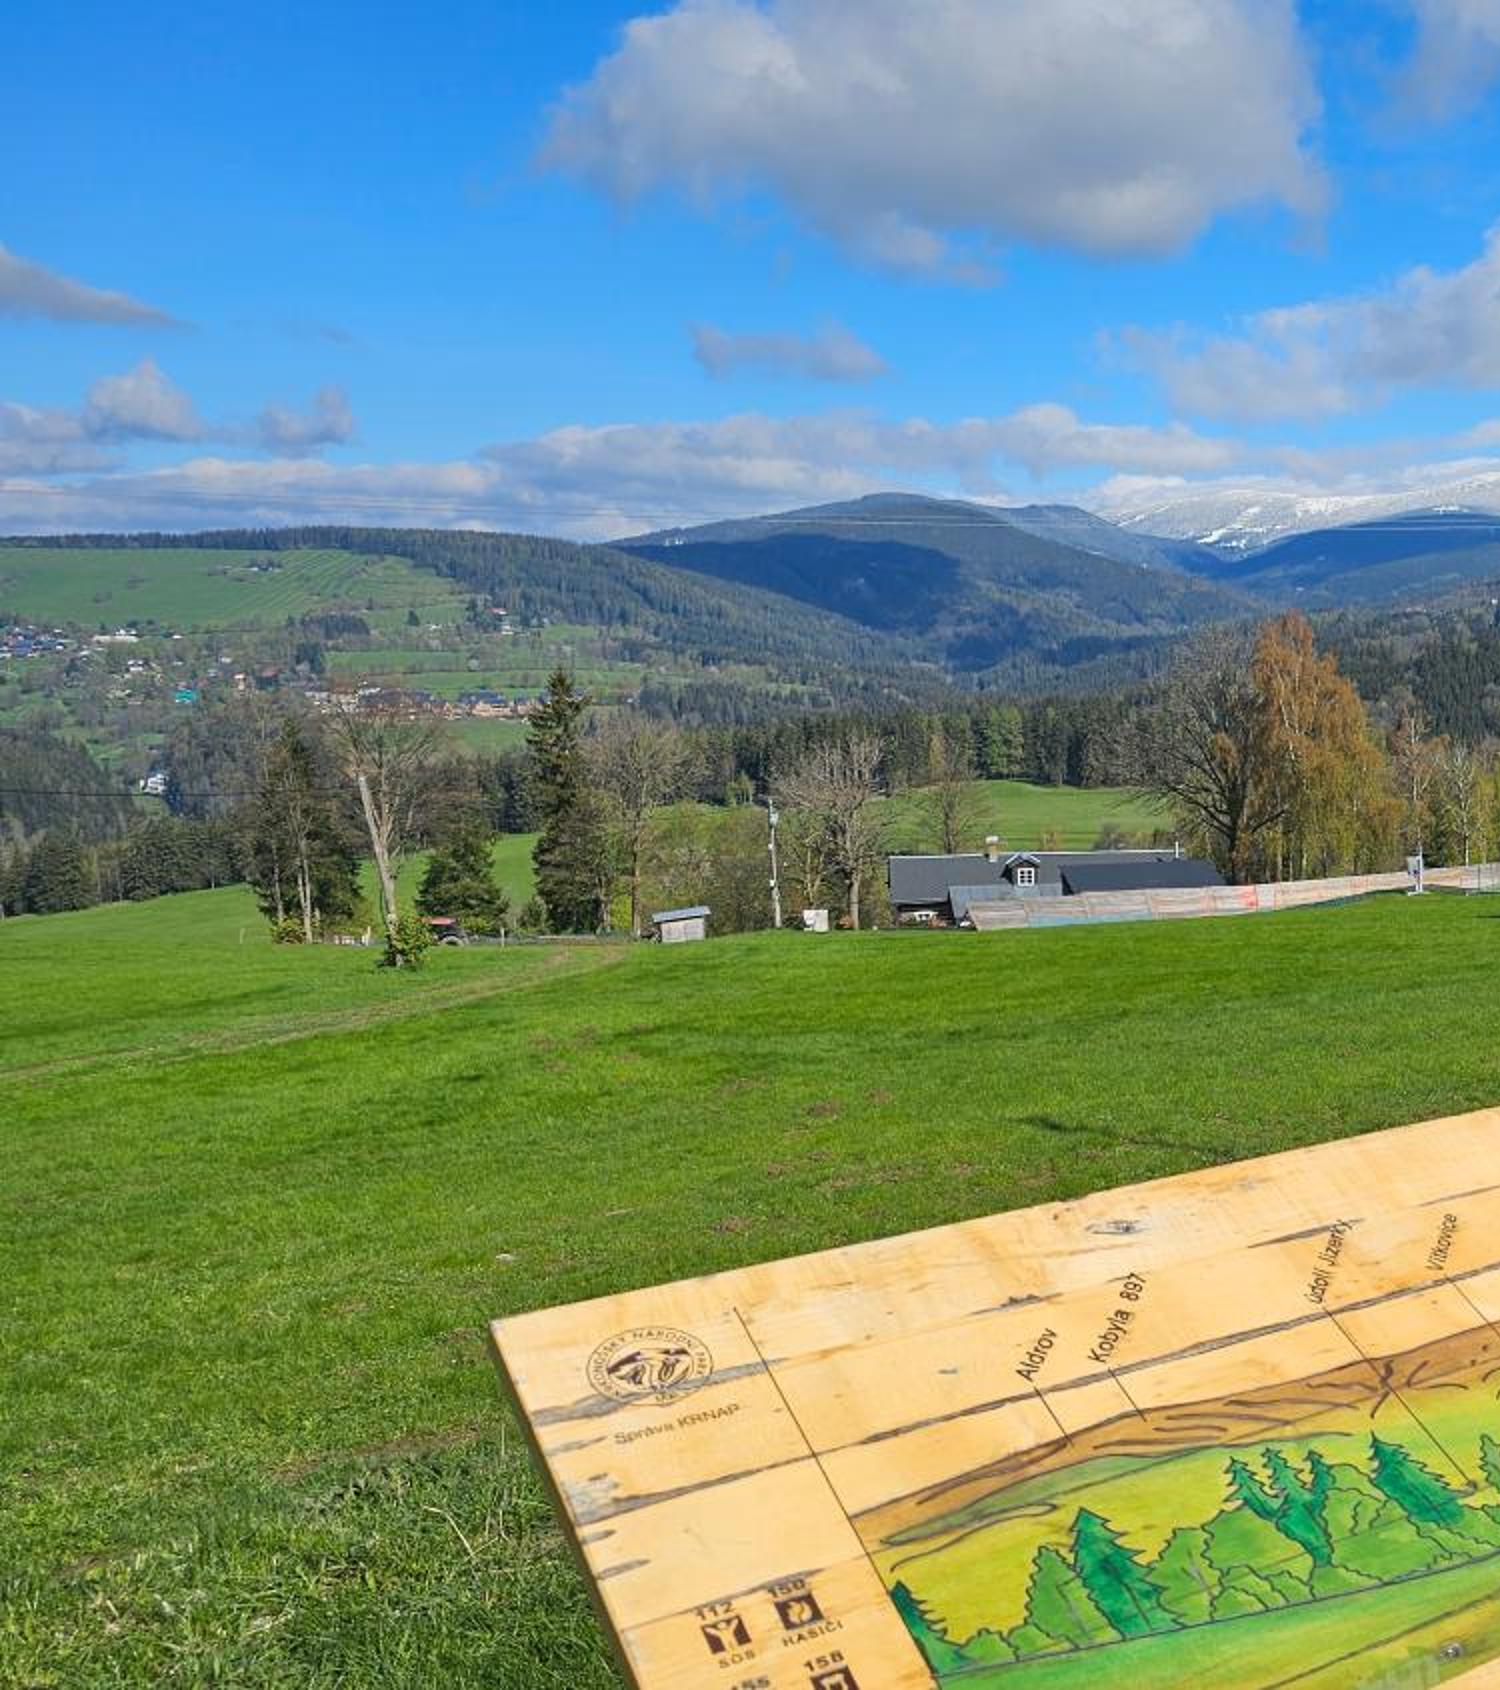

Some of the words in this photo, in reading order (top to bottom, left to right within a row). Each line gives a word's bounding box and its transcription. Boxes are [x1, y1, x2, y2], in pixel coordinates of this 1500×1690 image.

[1087, 1308, 1131, 1364] Kobyla
[1119, 1271, 1147, 1302] 897
[1014, 1327, 1057, 1383] Aldrov
[677, 1403, 741, 1428] KRNAP
[696, 1601, 734, 1621] 112
[782, 1620, 844, 1647] HASIČI
[718, 1649, 756, 1669] SOS
[804, 1650, 845, 1673] 158
